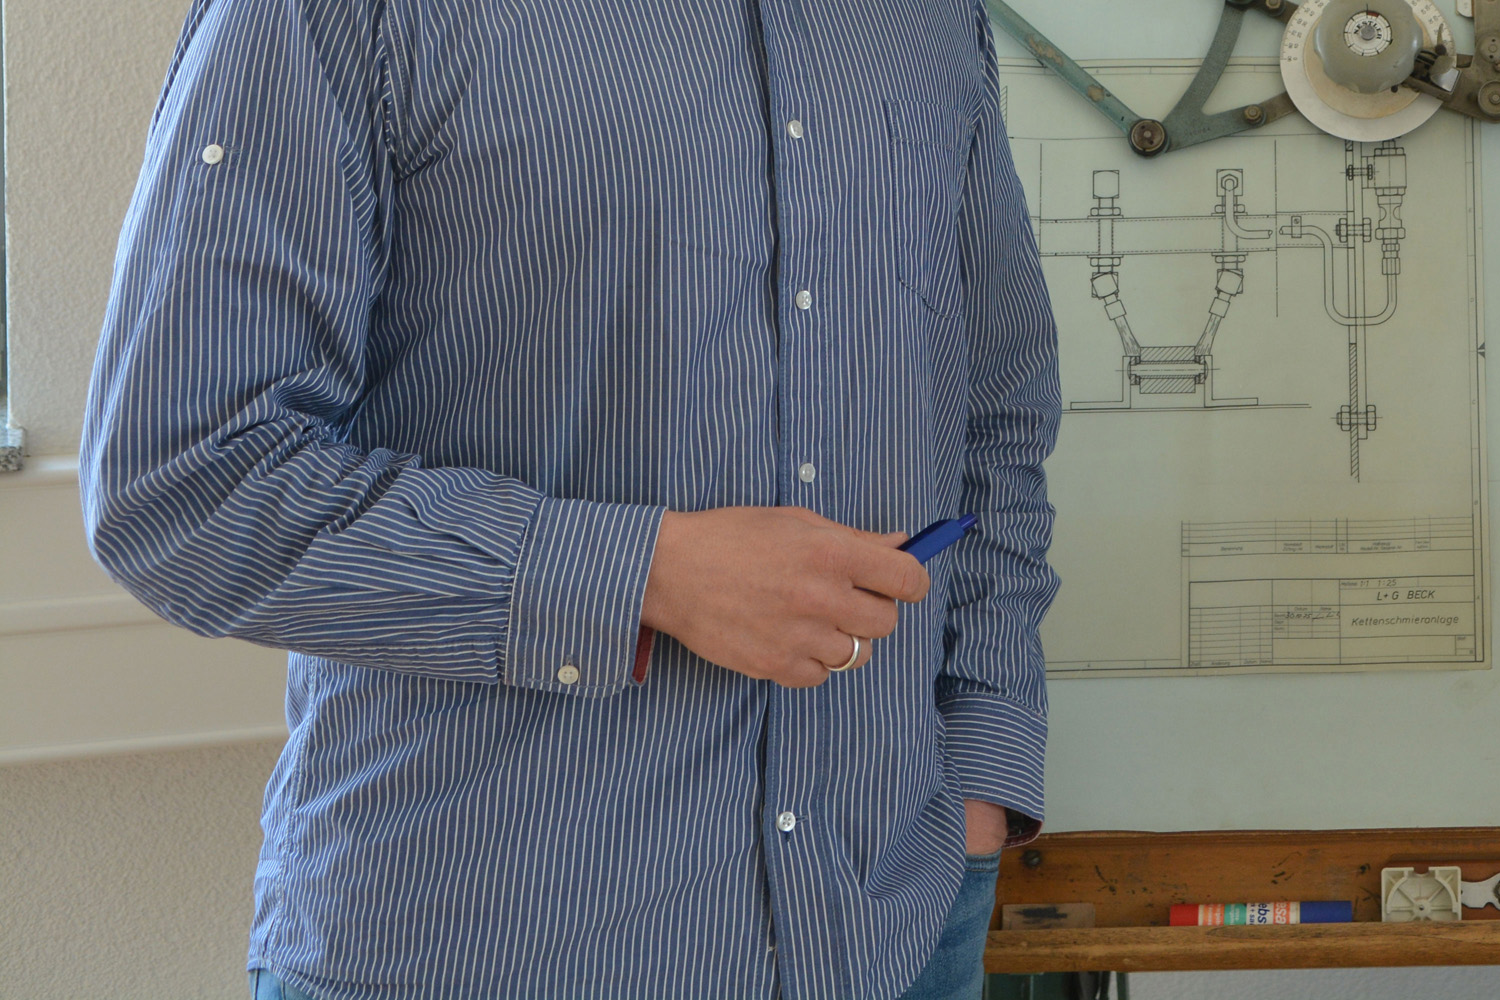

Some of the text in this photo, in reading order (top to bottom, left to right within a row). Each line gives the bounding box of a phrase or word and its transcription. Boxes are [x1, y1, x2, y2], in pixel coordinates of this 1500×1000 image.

[1353, 20, 1383, 40] NESTLER
[1407, 590, 1436, 600] BECK
[1351, 615, 1460, 627] Kettenschmieranlage
